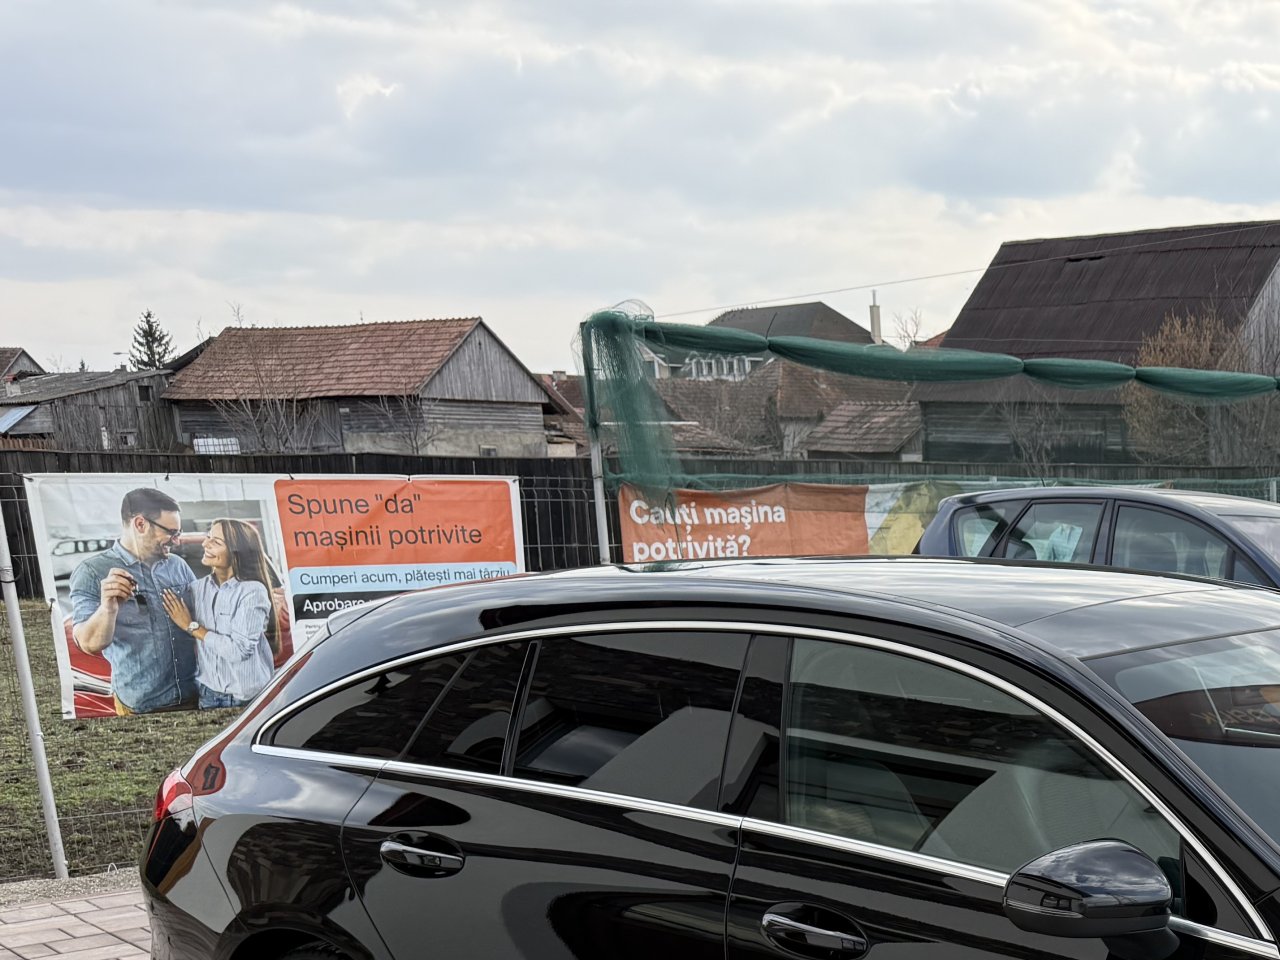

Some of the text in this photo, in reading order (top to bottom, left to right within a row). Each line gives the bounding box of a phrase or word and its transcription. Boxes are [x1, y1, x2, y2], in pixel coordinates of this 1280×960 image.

[288, 493, 421, 519] Spune "da"
[294, 524, 483, 551] mașinii potrivite
[632, 534, 751, 562] potrivită?
[300, 571, 357, 587] Cumperi
[362, 572, 402, 584] acum,
[405, 568, 450, 584] plătești
[454, 567, 476, 580] mai
